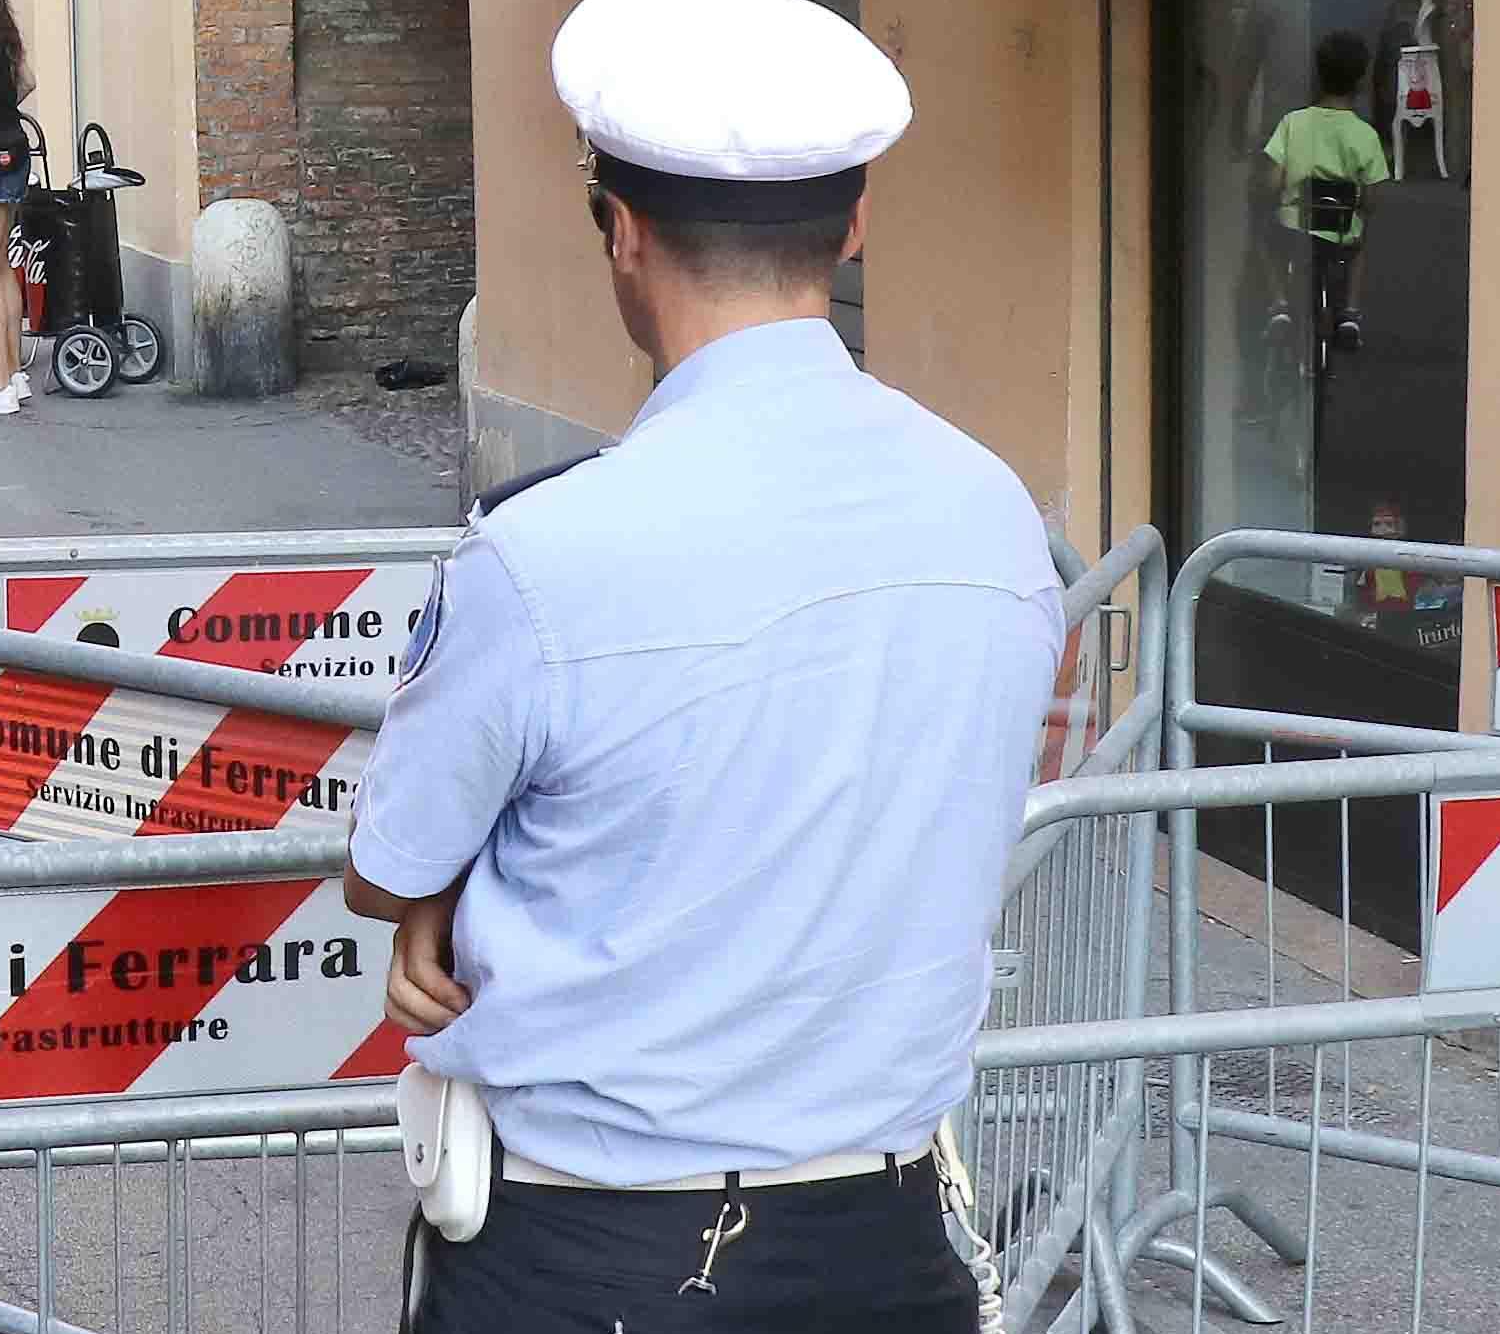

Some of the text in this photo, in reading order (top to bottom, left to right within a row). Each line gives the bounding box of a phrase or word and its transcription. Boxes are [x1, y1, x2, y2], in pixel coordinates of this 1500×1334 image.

[166, 605, 383, 645] Comune
[260, 654, 375, 679] Servizio
[26, 774, 116, 816] Servizio
[141, 734, 179, 782] di
[200, 744, 359, 814] Ferrar
[65, 931, 364, 996] Ferrara
